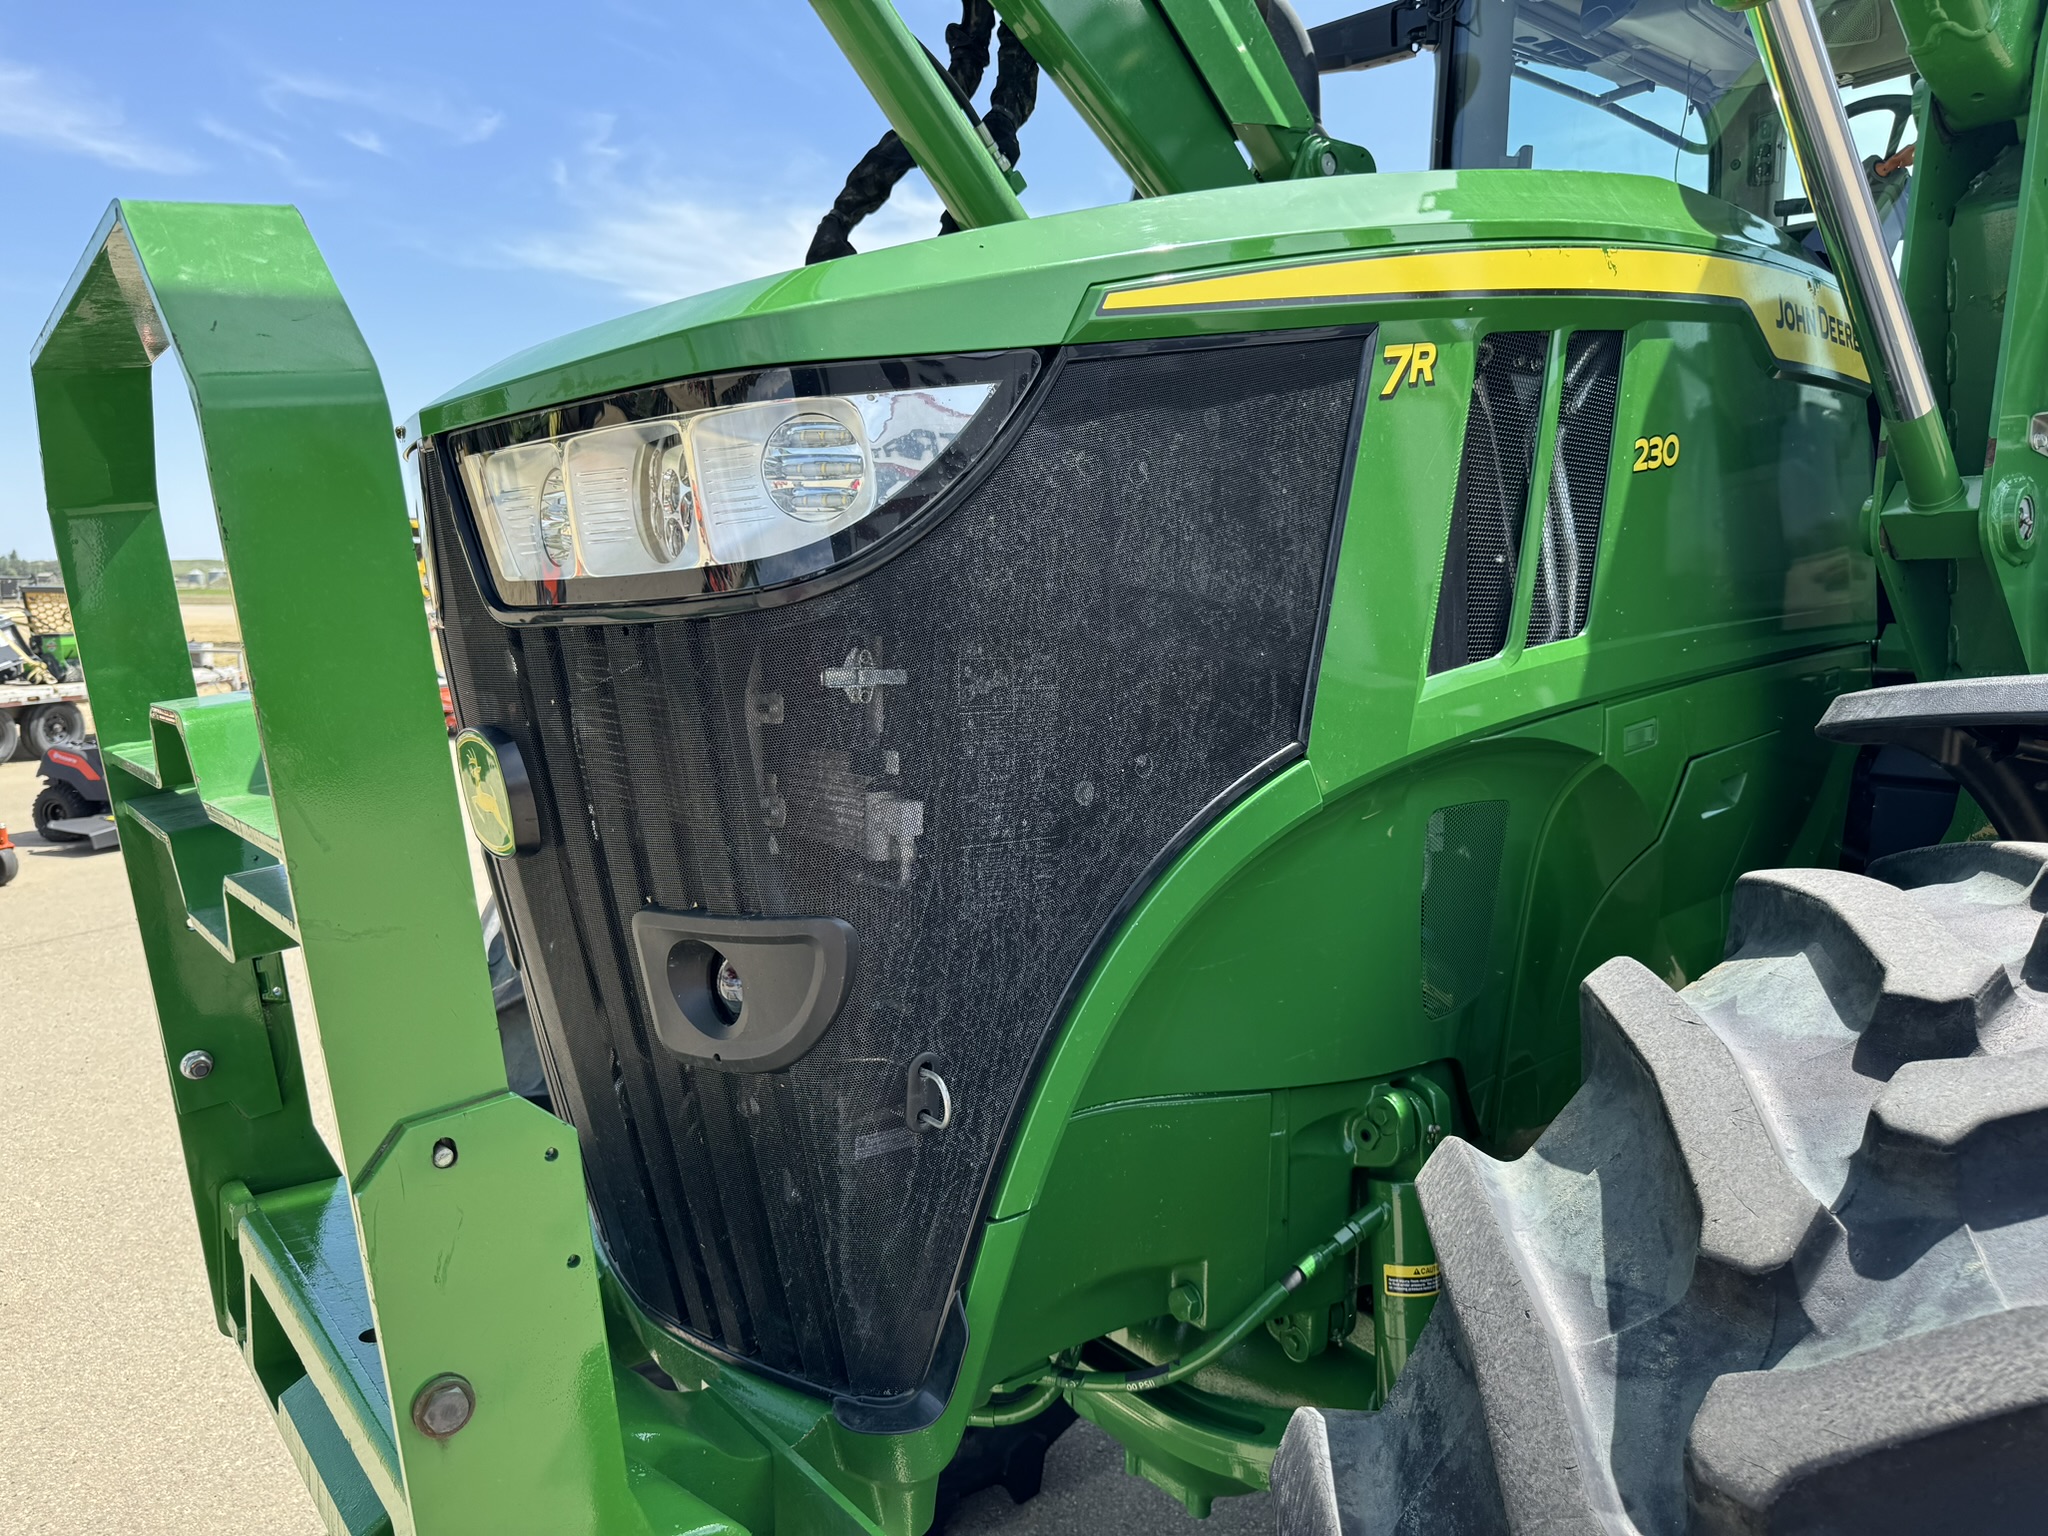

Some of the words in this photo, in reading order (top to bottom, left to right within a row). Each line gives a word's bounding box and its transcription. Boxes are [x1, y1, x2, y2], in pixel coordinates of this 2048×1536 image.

[1776, 294, 1817, 337] JOHN
[1380, 342, 1437, 399] 7R
[1633, 433, 1680, 473] 230
